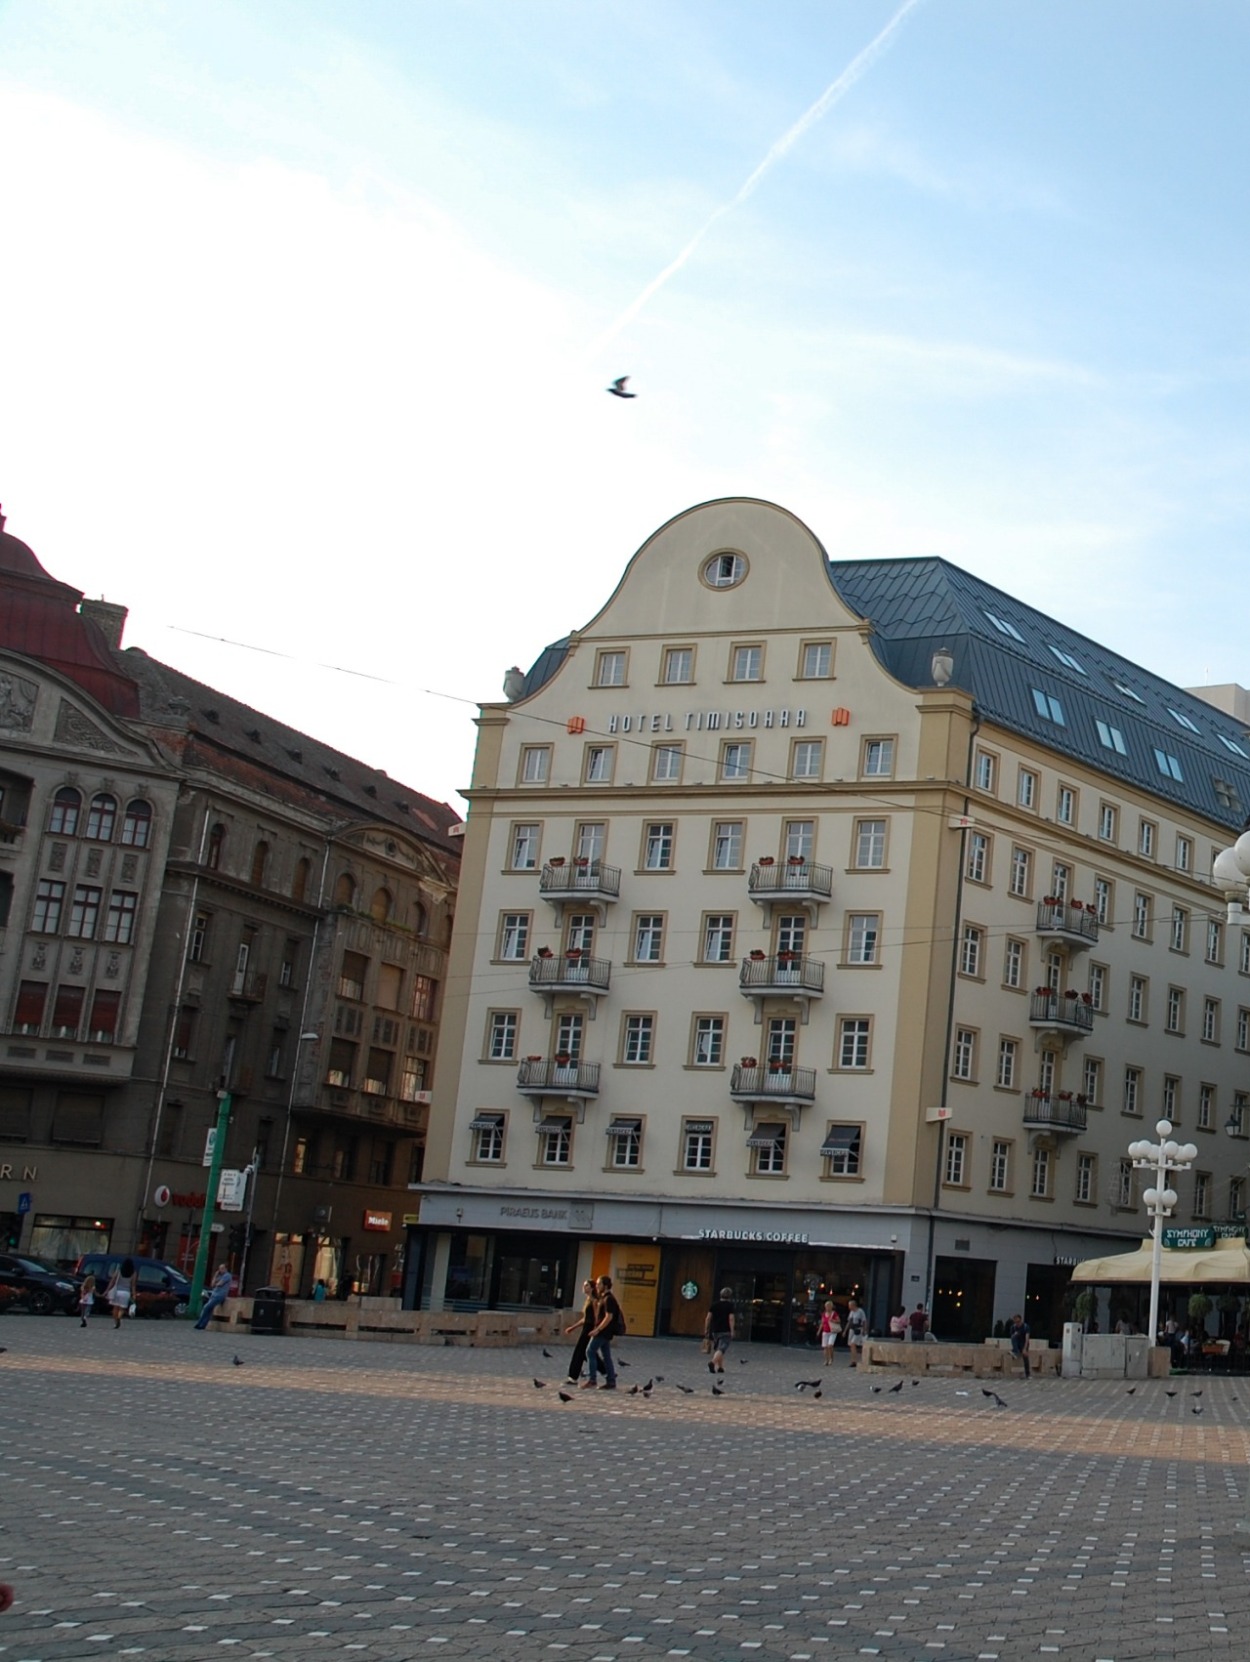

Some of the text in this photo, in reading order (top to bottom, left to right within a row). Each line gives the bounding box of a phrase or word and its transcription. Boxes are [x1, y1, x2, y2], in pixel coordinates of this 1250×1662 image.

[608, 709, 806, 733] HOTEL TIMISOARA
[500, 1206, 568, 1220] PIRAEUS BANK
[368, 1215, 389, 1226] Miele
[698, 1228, 808, 1243] STARBUCKS COFFEE
[1166, 1229, 1209, 1238] SYMPHONY
